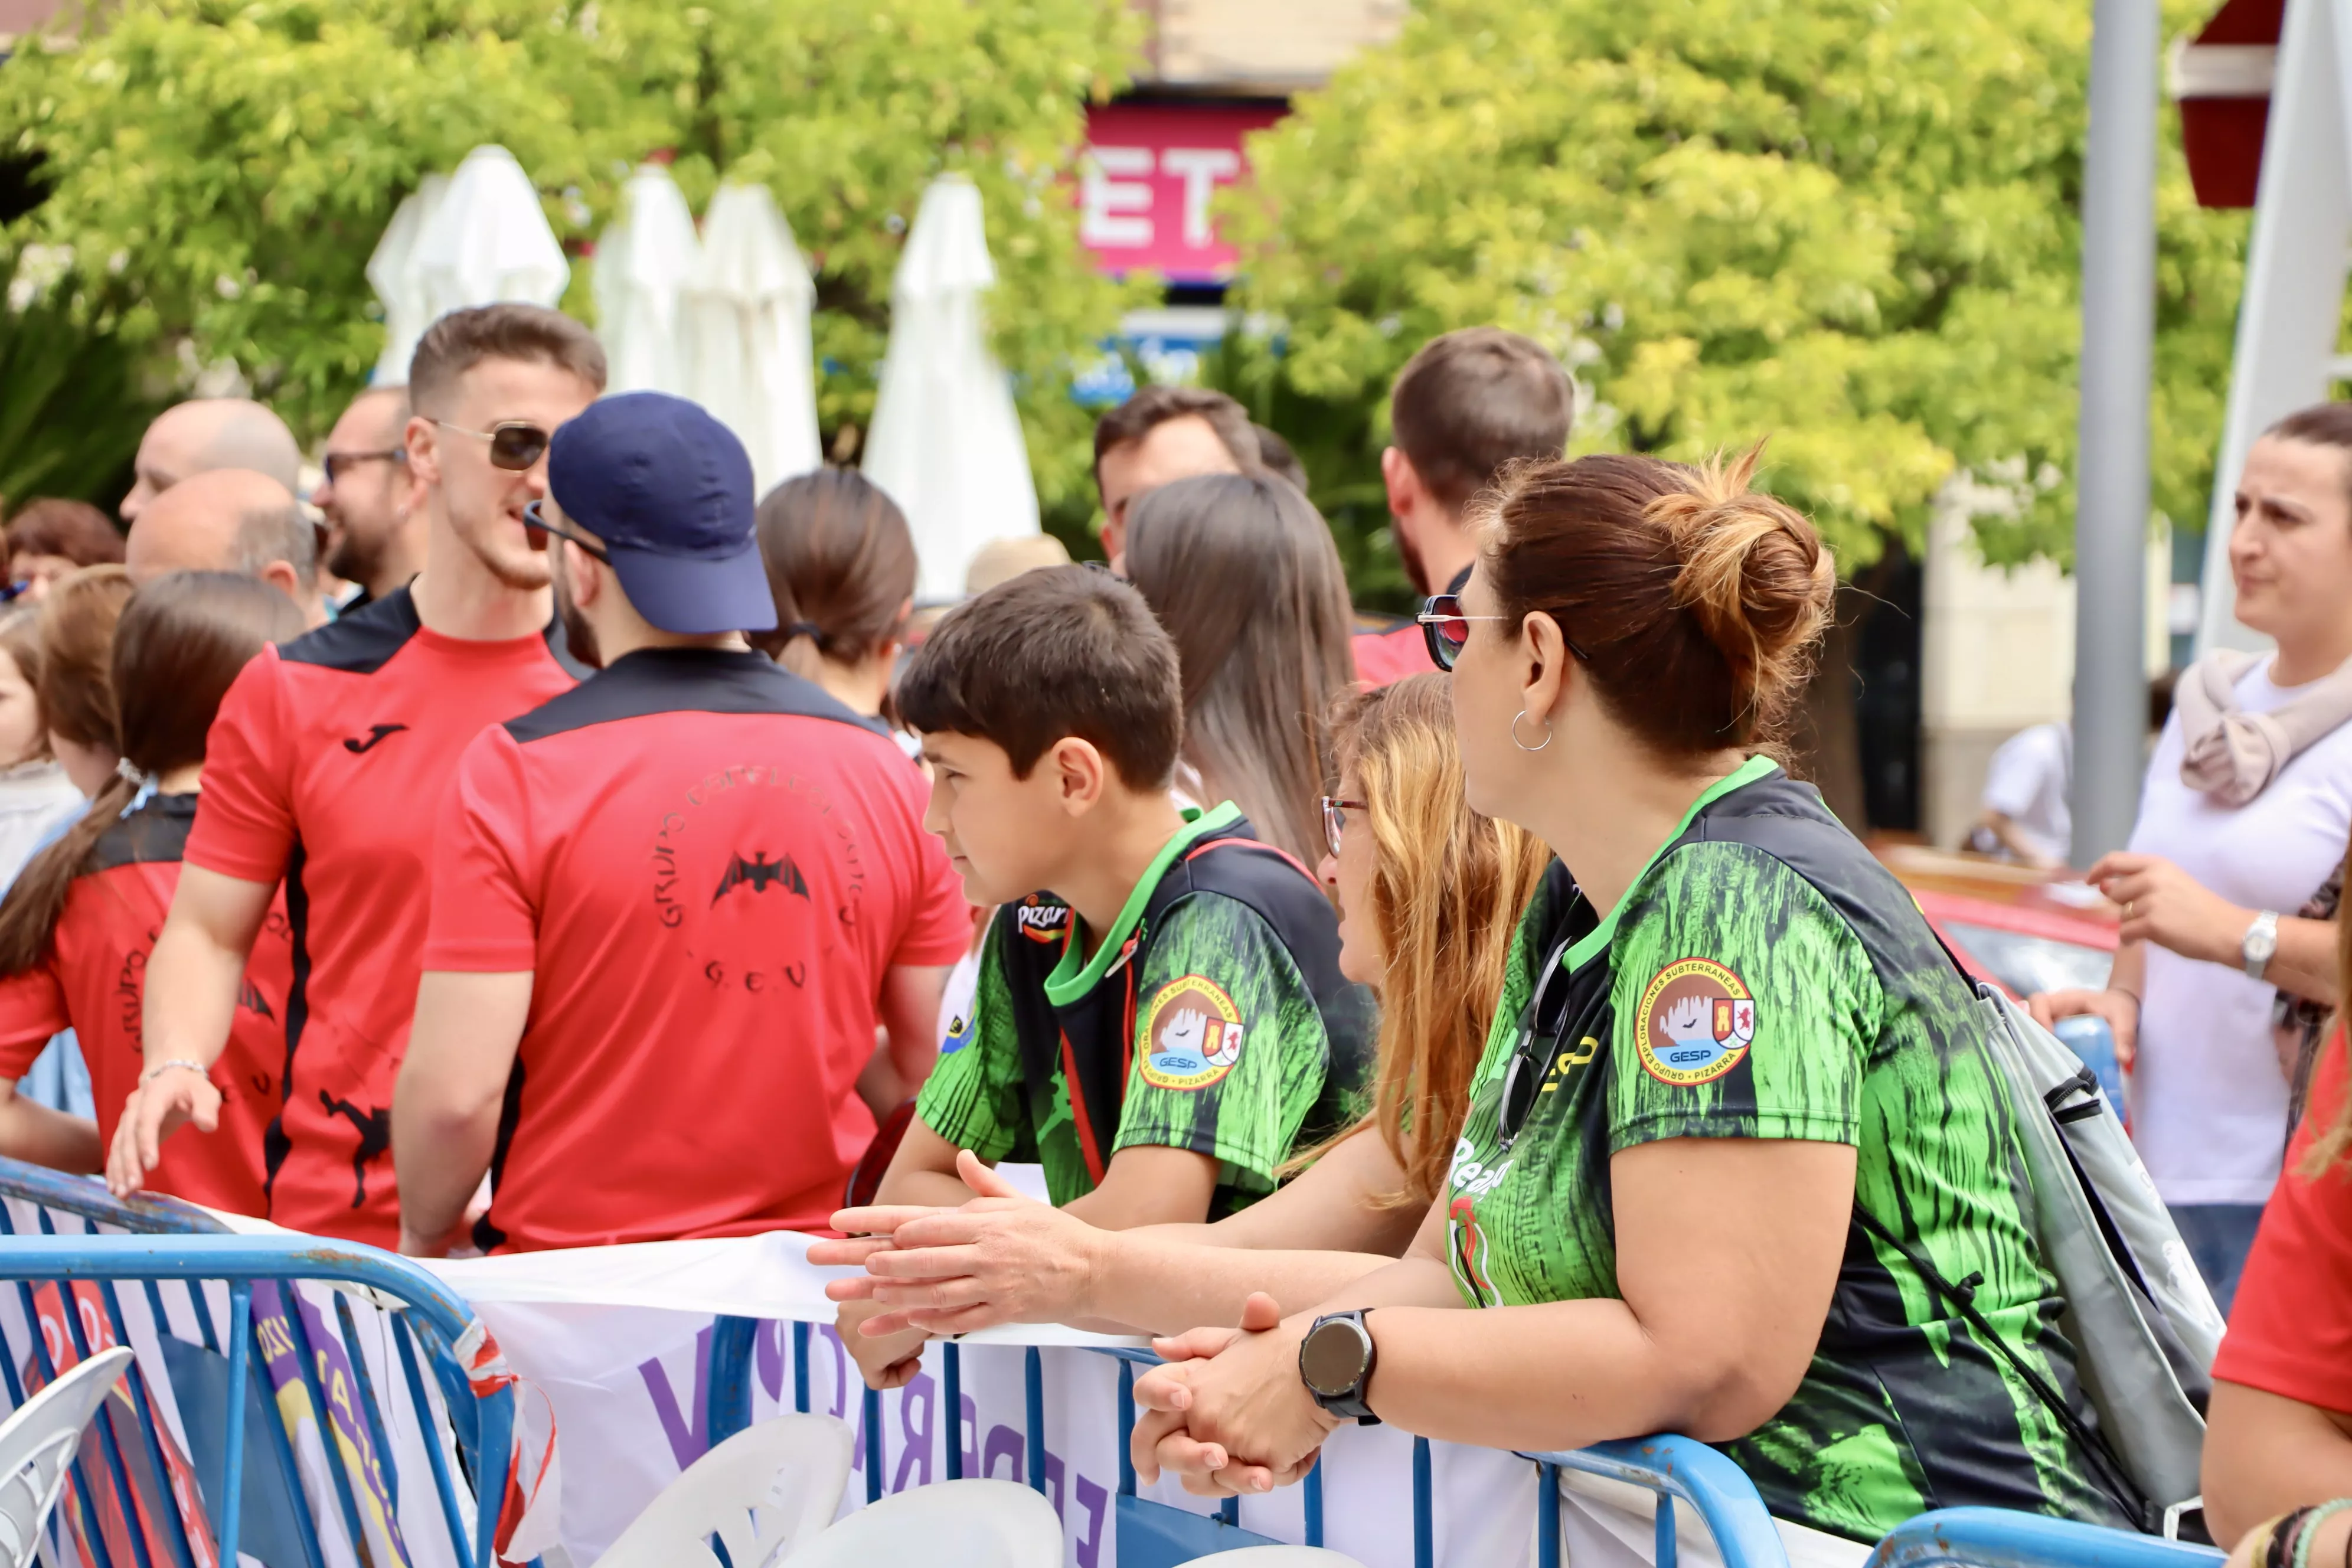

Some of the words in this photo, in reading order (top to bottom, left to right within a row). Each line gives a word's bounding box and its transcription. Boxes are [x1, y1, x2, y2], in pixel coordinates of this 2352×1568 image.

[652, 811, 685, 929] GRUPO
[1666, 963, 1741, 997] SUBTERRANEAS
[1639, 979, 1665, 1064] EXPLORACIONES
[1159, 1057, 1198, 1070] GESP
[1670, 1050, 1711, 1063] GESP
[1694, 1052, 1736, 1080] PIZARRA
[1178, 1068, 1220, 1086] PIZARRA
[1653, 1062, 1685, 1081] GRUPO
